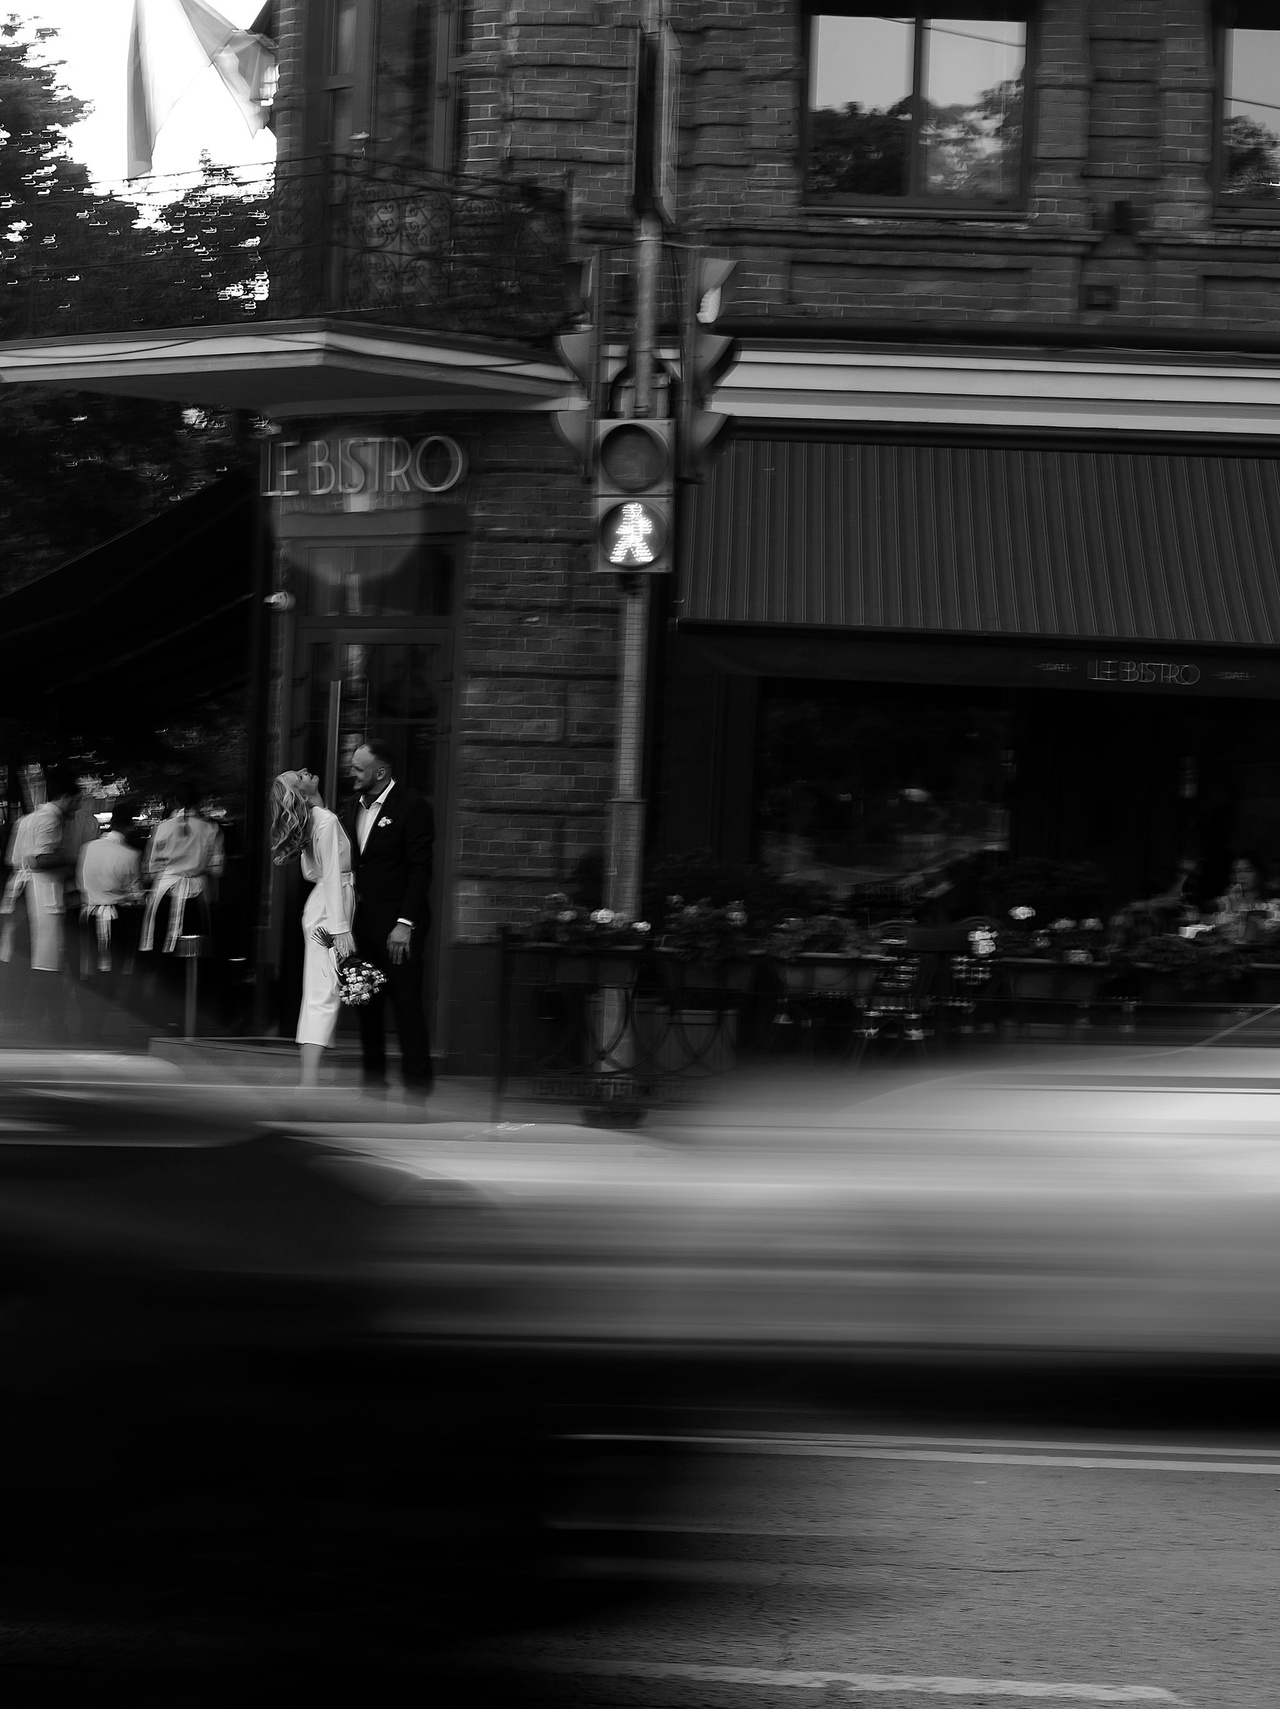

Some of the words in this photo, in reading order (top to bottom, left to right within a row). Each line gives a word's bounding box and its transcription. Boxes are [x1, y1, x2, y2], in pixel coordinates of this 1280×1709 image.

[259, 440, 300, 497] LE
[307, 435, 465, 496] BISTRO
[1087, 659, 1119, 681] LE
[1121, 660, 1201, 686] BISTRO
